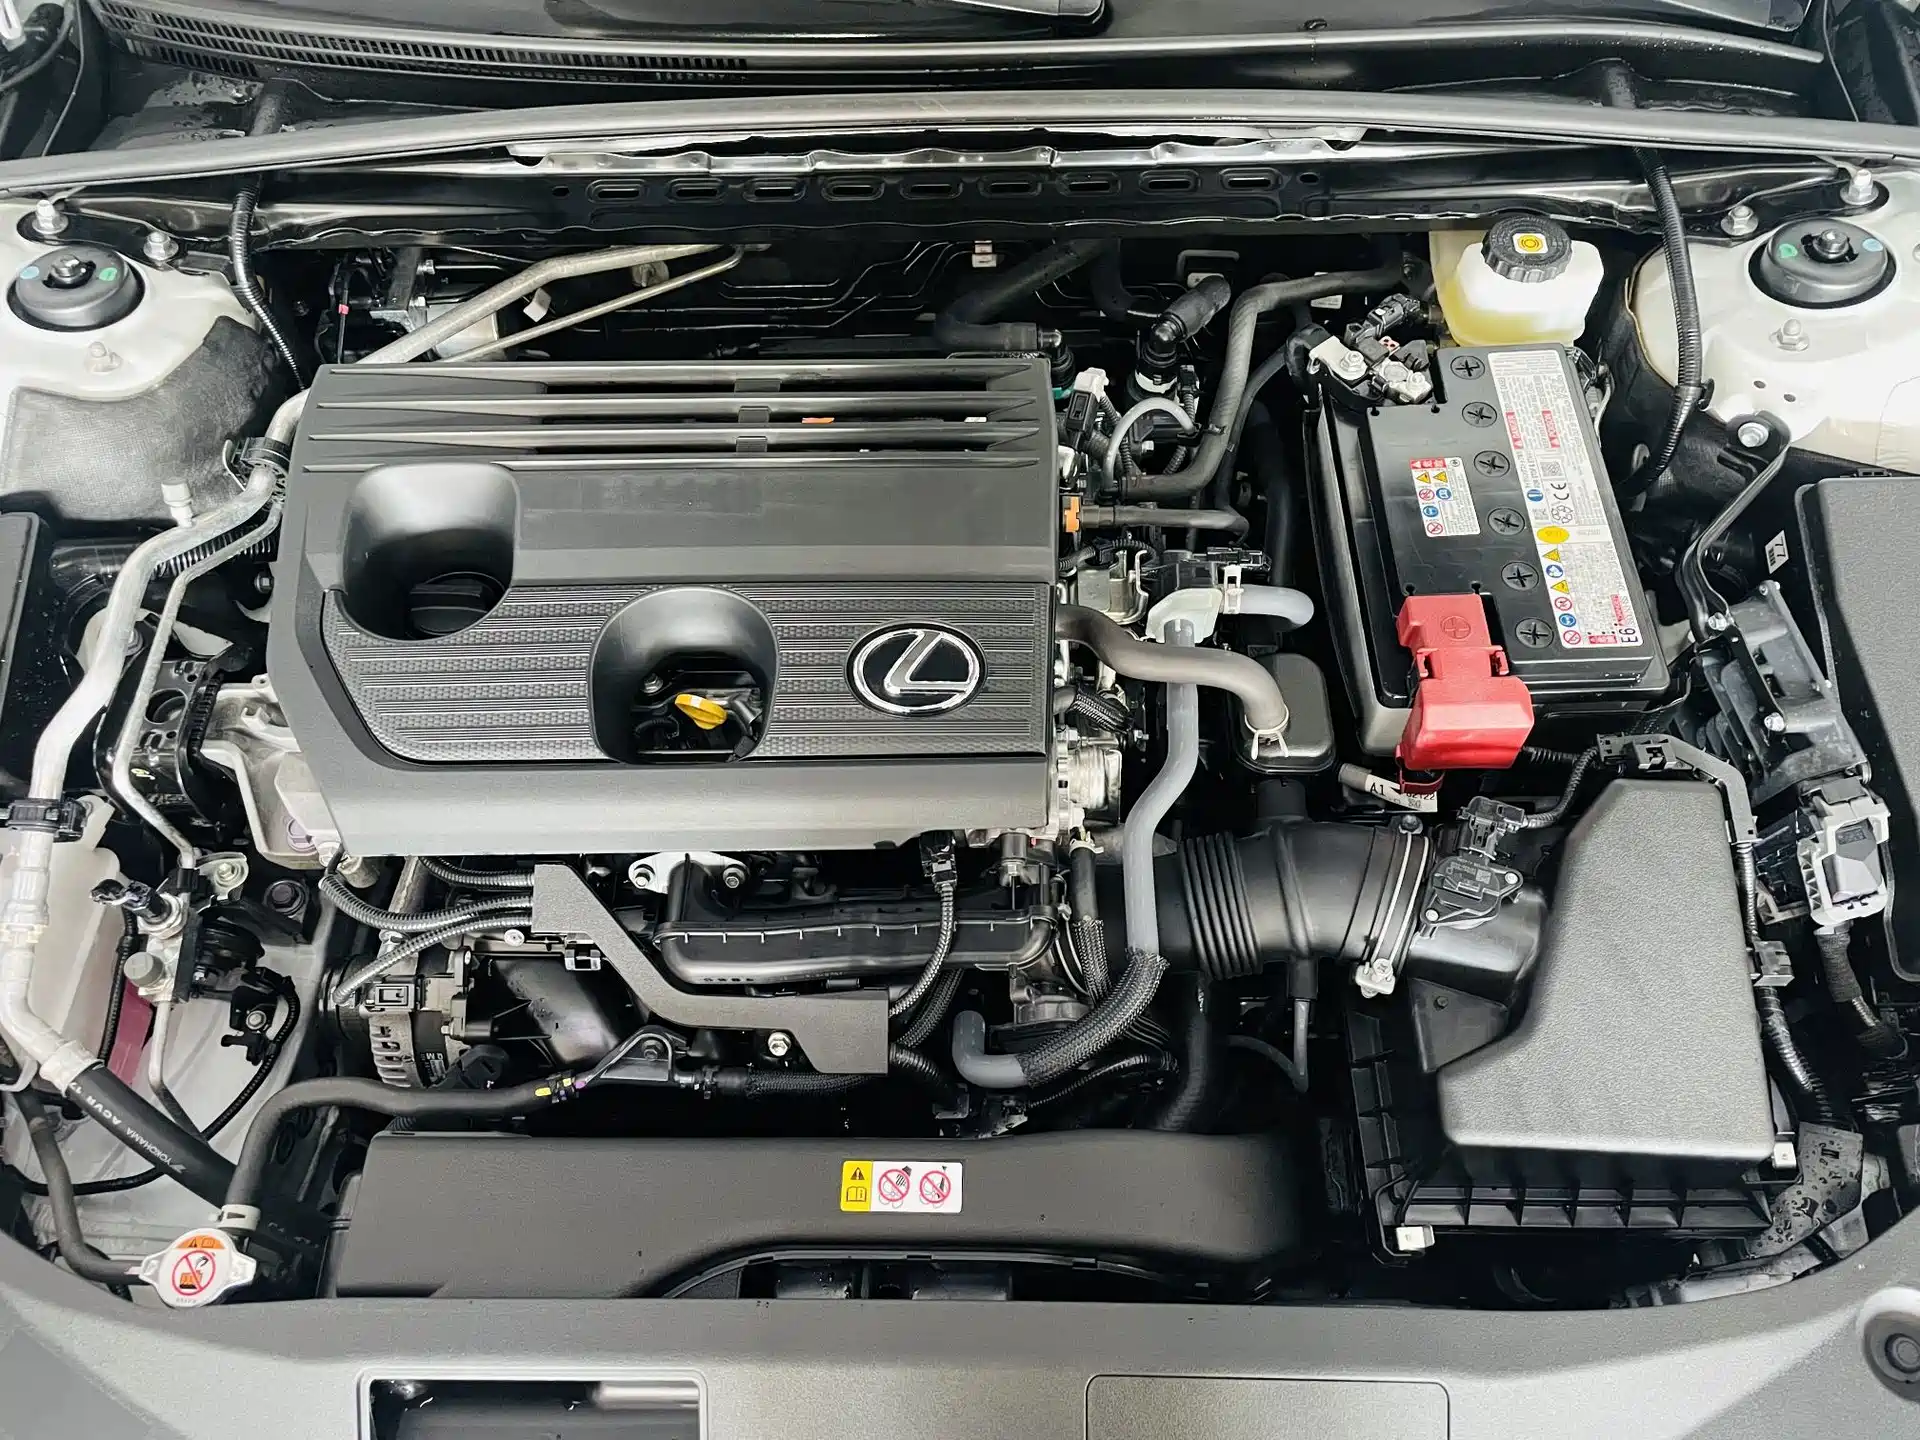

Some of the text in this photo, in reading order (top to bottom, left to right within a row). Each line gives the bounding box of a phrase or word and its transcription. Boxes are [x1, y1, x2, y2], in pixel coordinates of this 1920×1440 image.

[1543, 413, 1557, 437] POISON
[1550, 482, 1570, 501] CE
[1618, 627, 1639, 643] E6
[1370, 782, 1386, 797] A1
[86, 1095, 122, 1125] ACVR
[125, 1126, 173, 1166] YOKOHAMA
